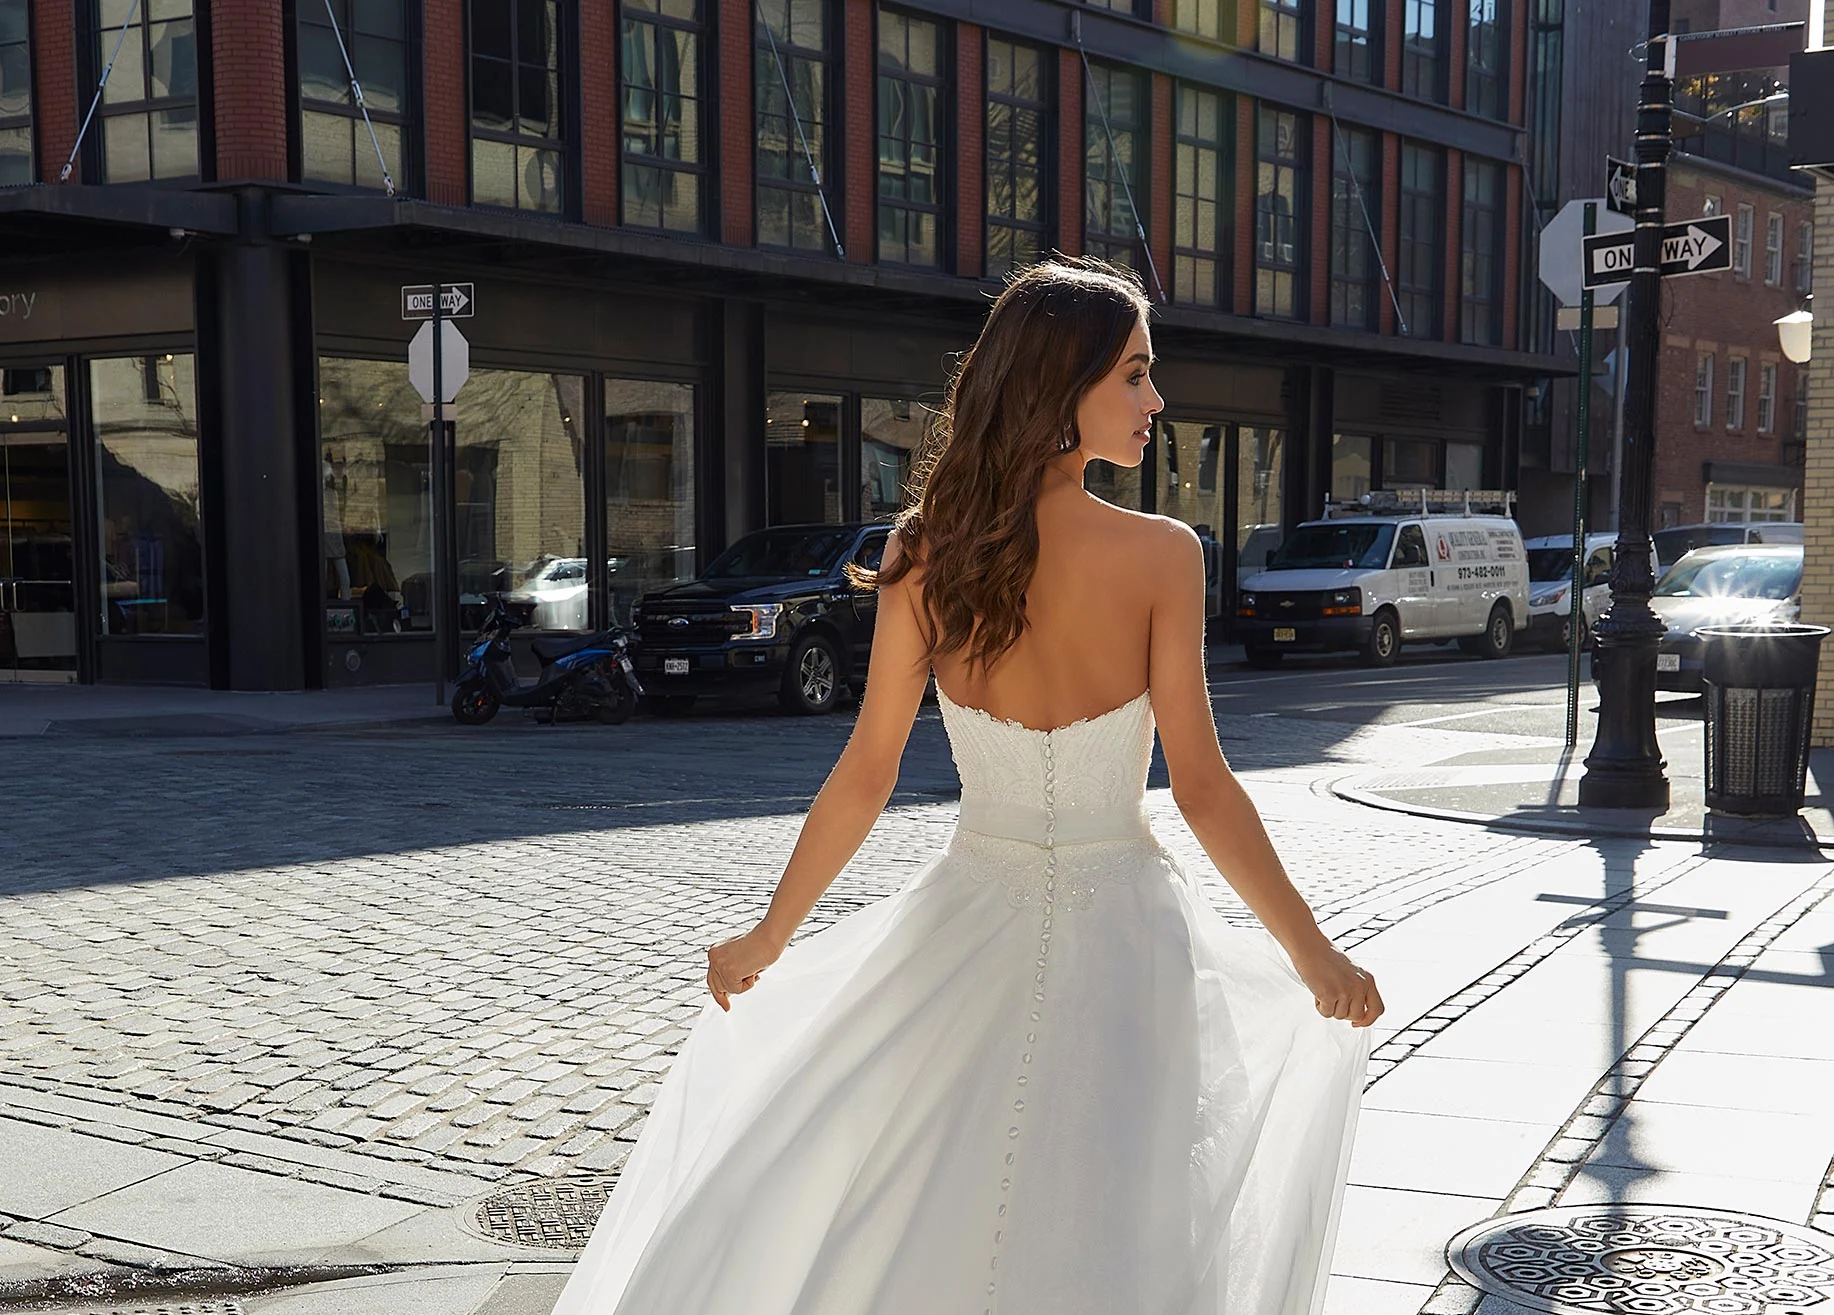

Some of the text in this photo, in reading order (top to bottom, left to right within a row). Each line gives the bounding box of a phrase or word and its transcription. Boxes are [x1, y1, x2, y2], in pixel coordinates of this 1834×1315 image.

[1604, 236, 1708, 269] ON WAY
[412, 294, 462, 308] ONE WAY
[1458, 565, 1505, 579] 973-482-0011
